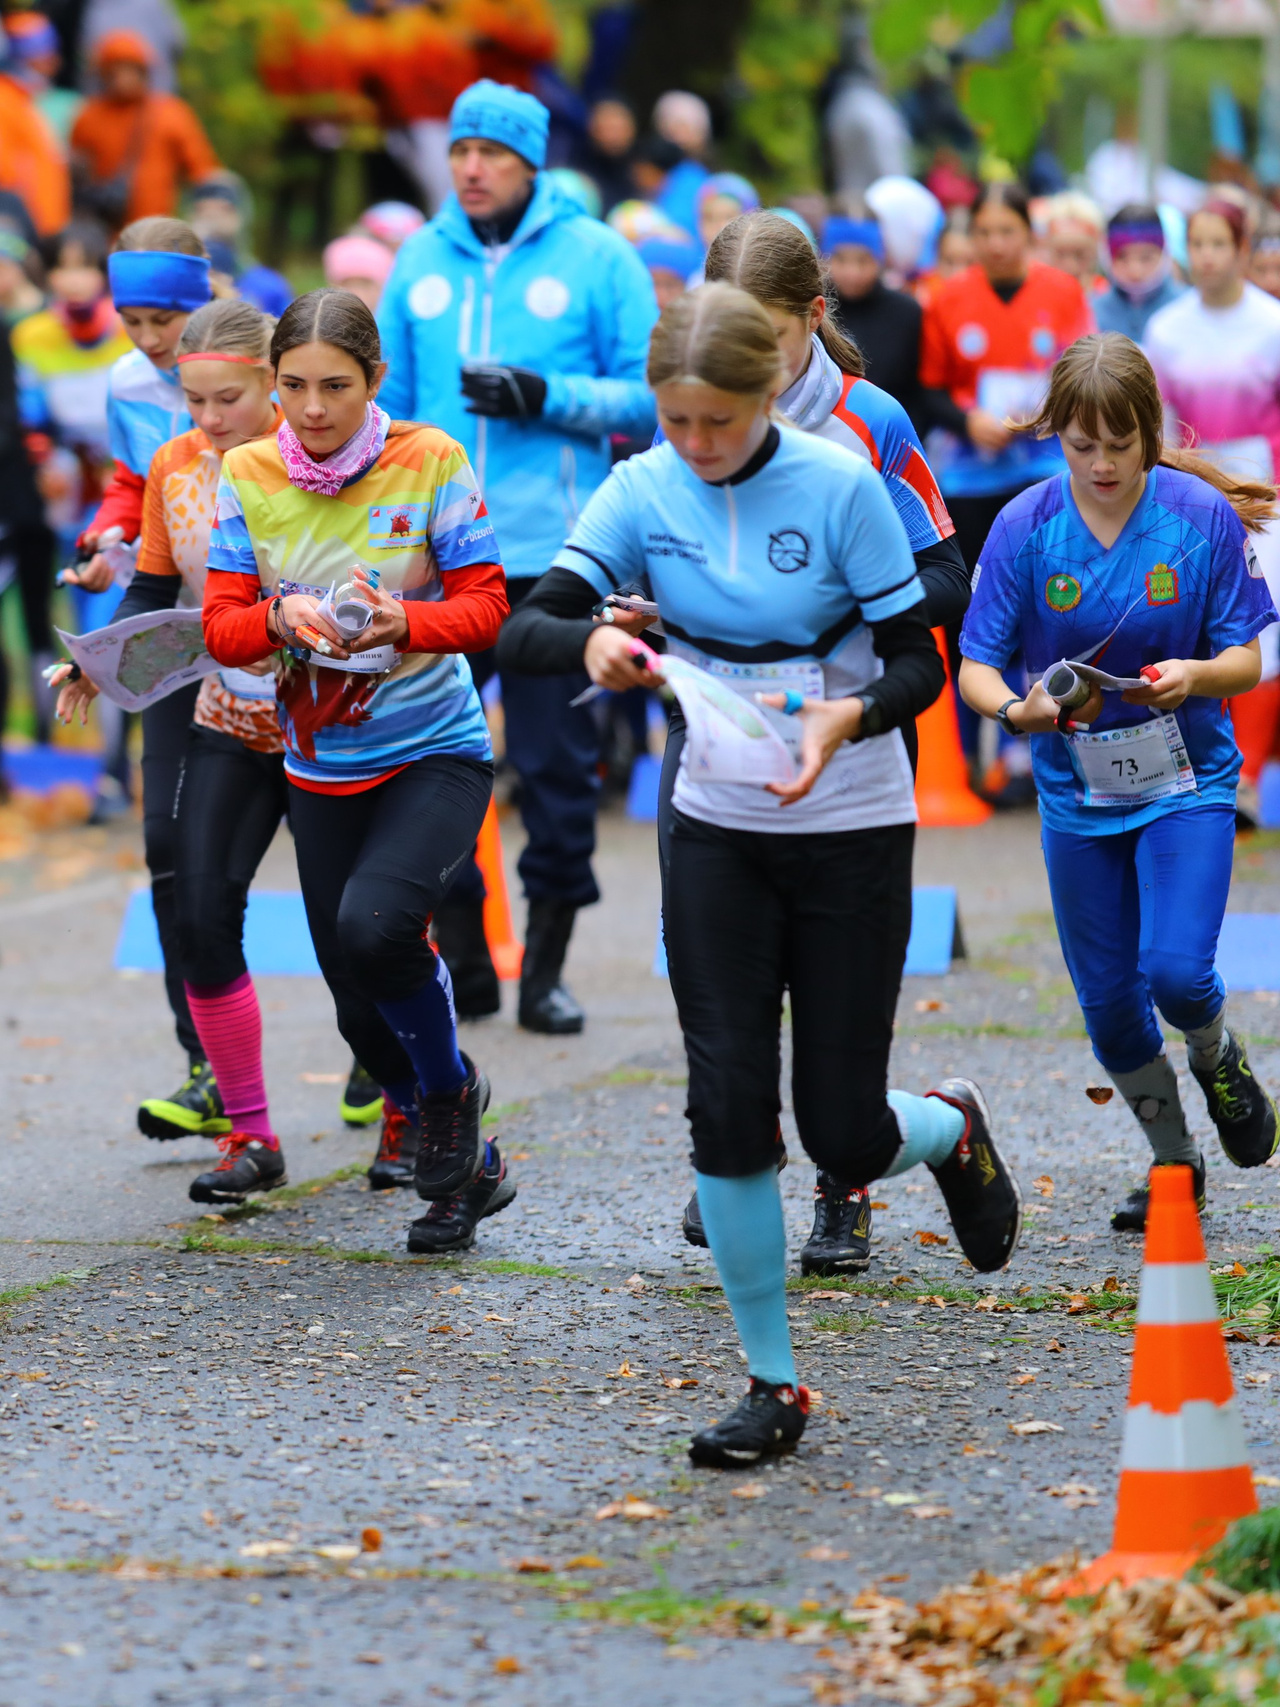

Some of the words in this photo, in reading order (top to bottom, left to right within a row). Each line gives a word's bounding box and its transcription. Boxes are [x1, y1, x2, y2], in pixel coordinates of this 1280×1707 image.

[470, 496, 477, 504] 34
[1112, 758, 1139, 777] 73
[1137, 771, 1165, 783] линия
